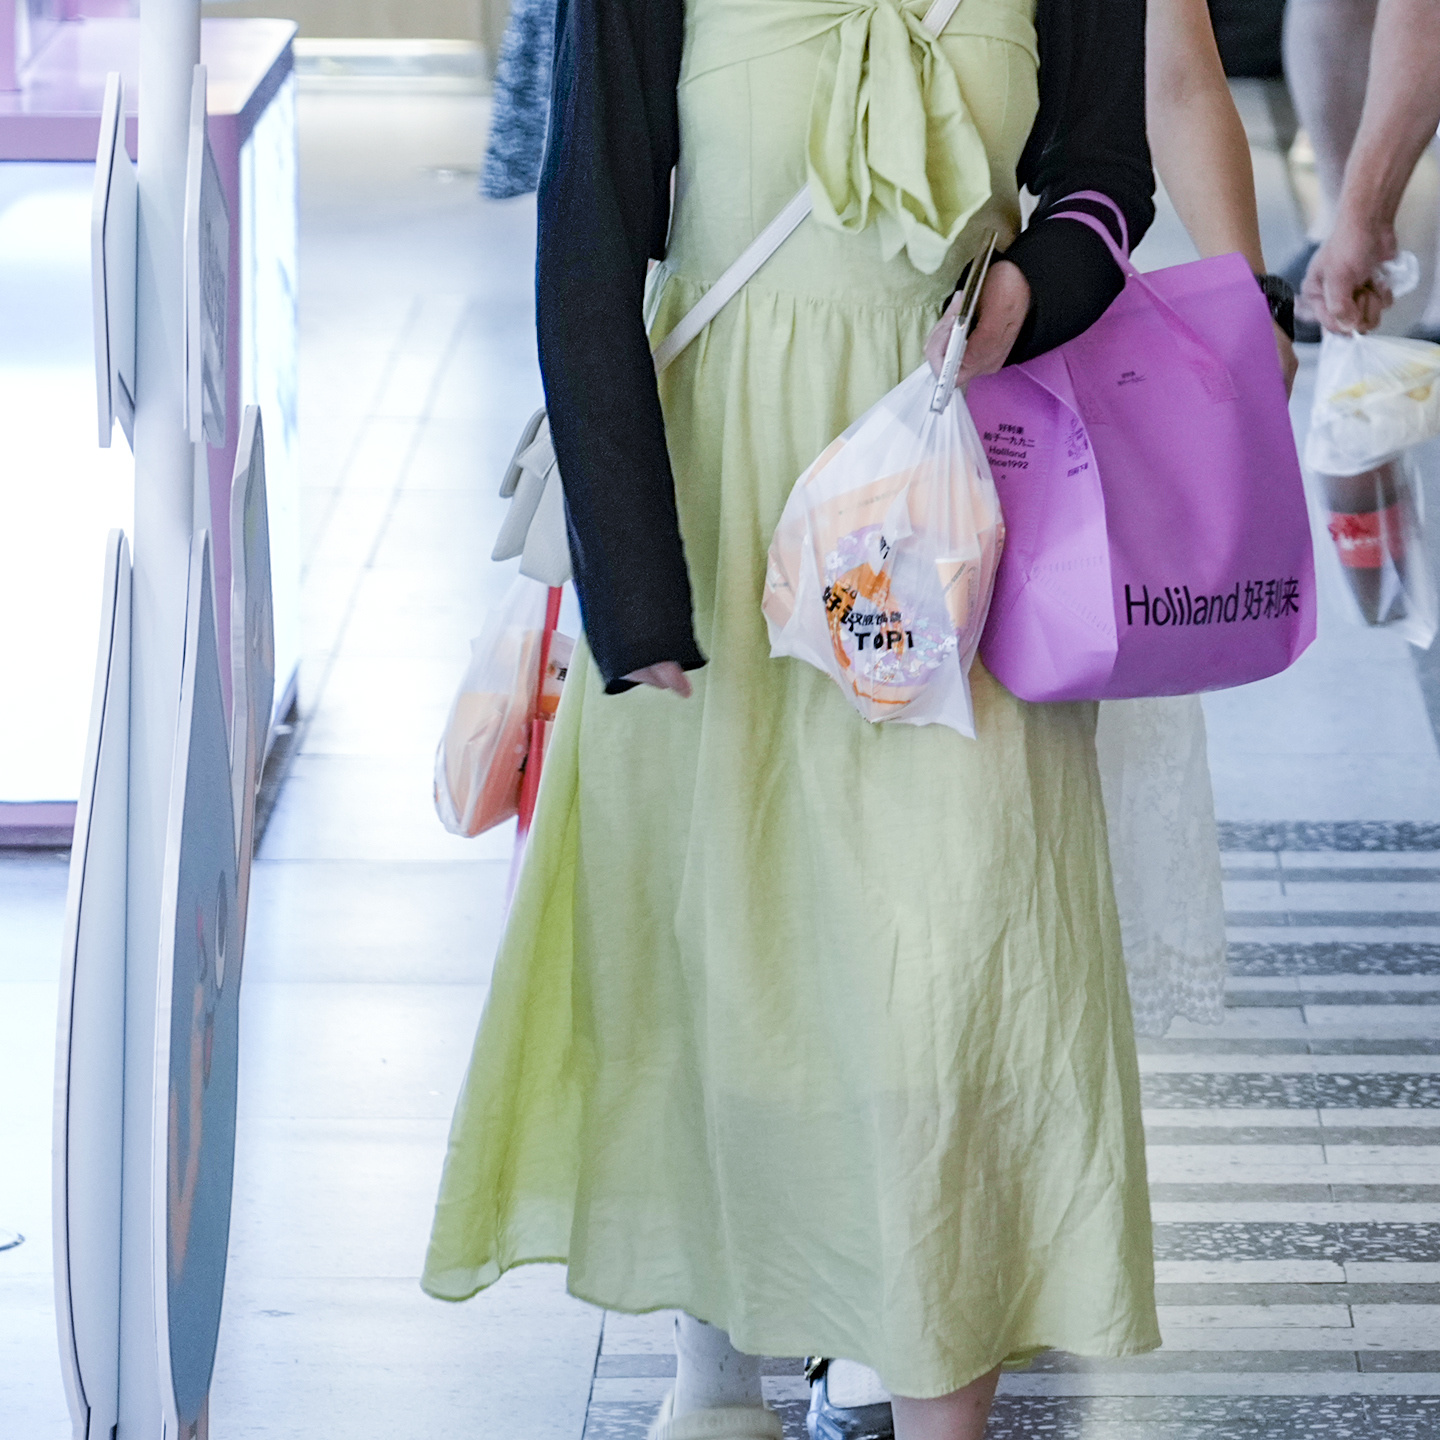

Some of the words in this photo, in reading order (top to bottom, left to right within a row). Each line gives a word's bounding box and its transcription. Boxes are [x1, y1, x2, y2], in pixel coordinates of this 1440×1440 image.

[987, 456, 1029, 470] ince1992
[1124, 581, 1240, 626] Holiland
[1242, 576, 1299, 622] 好利来
[854, 630, 914, 651] TOP1
